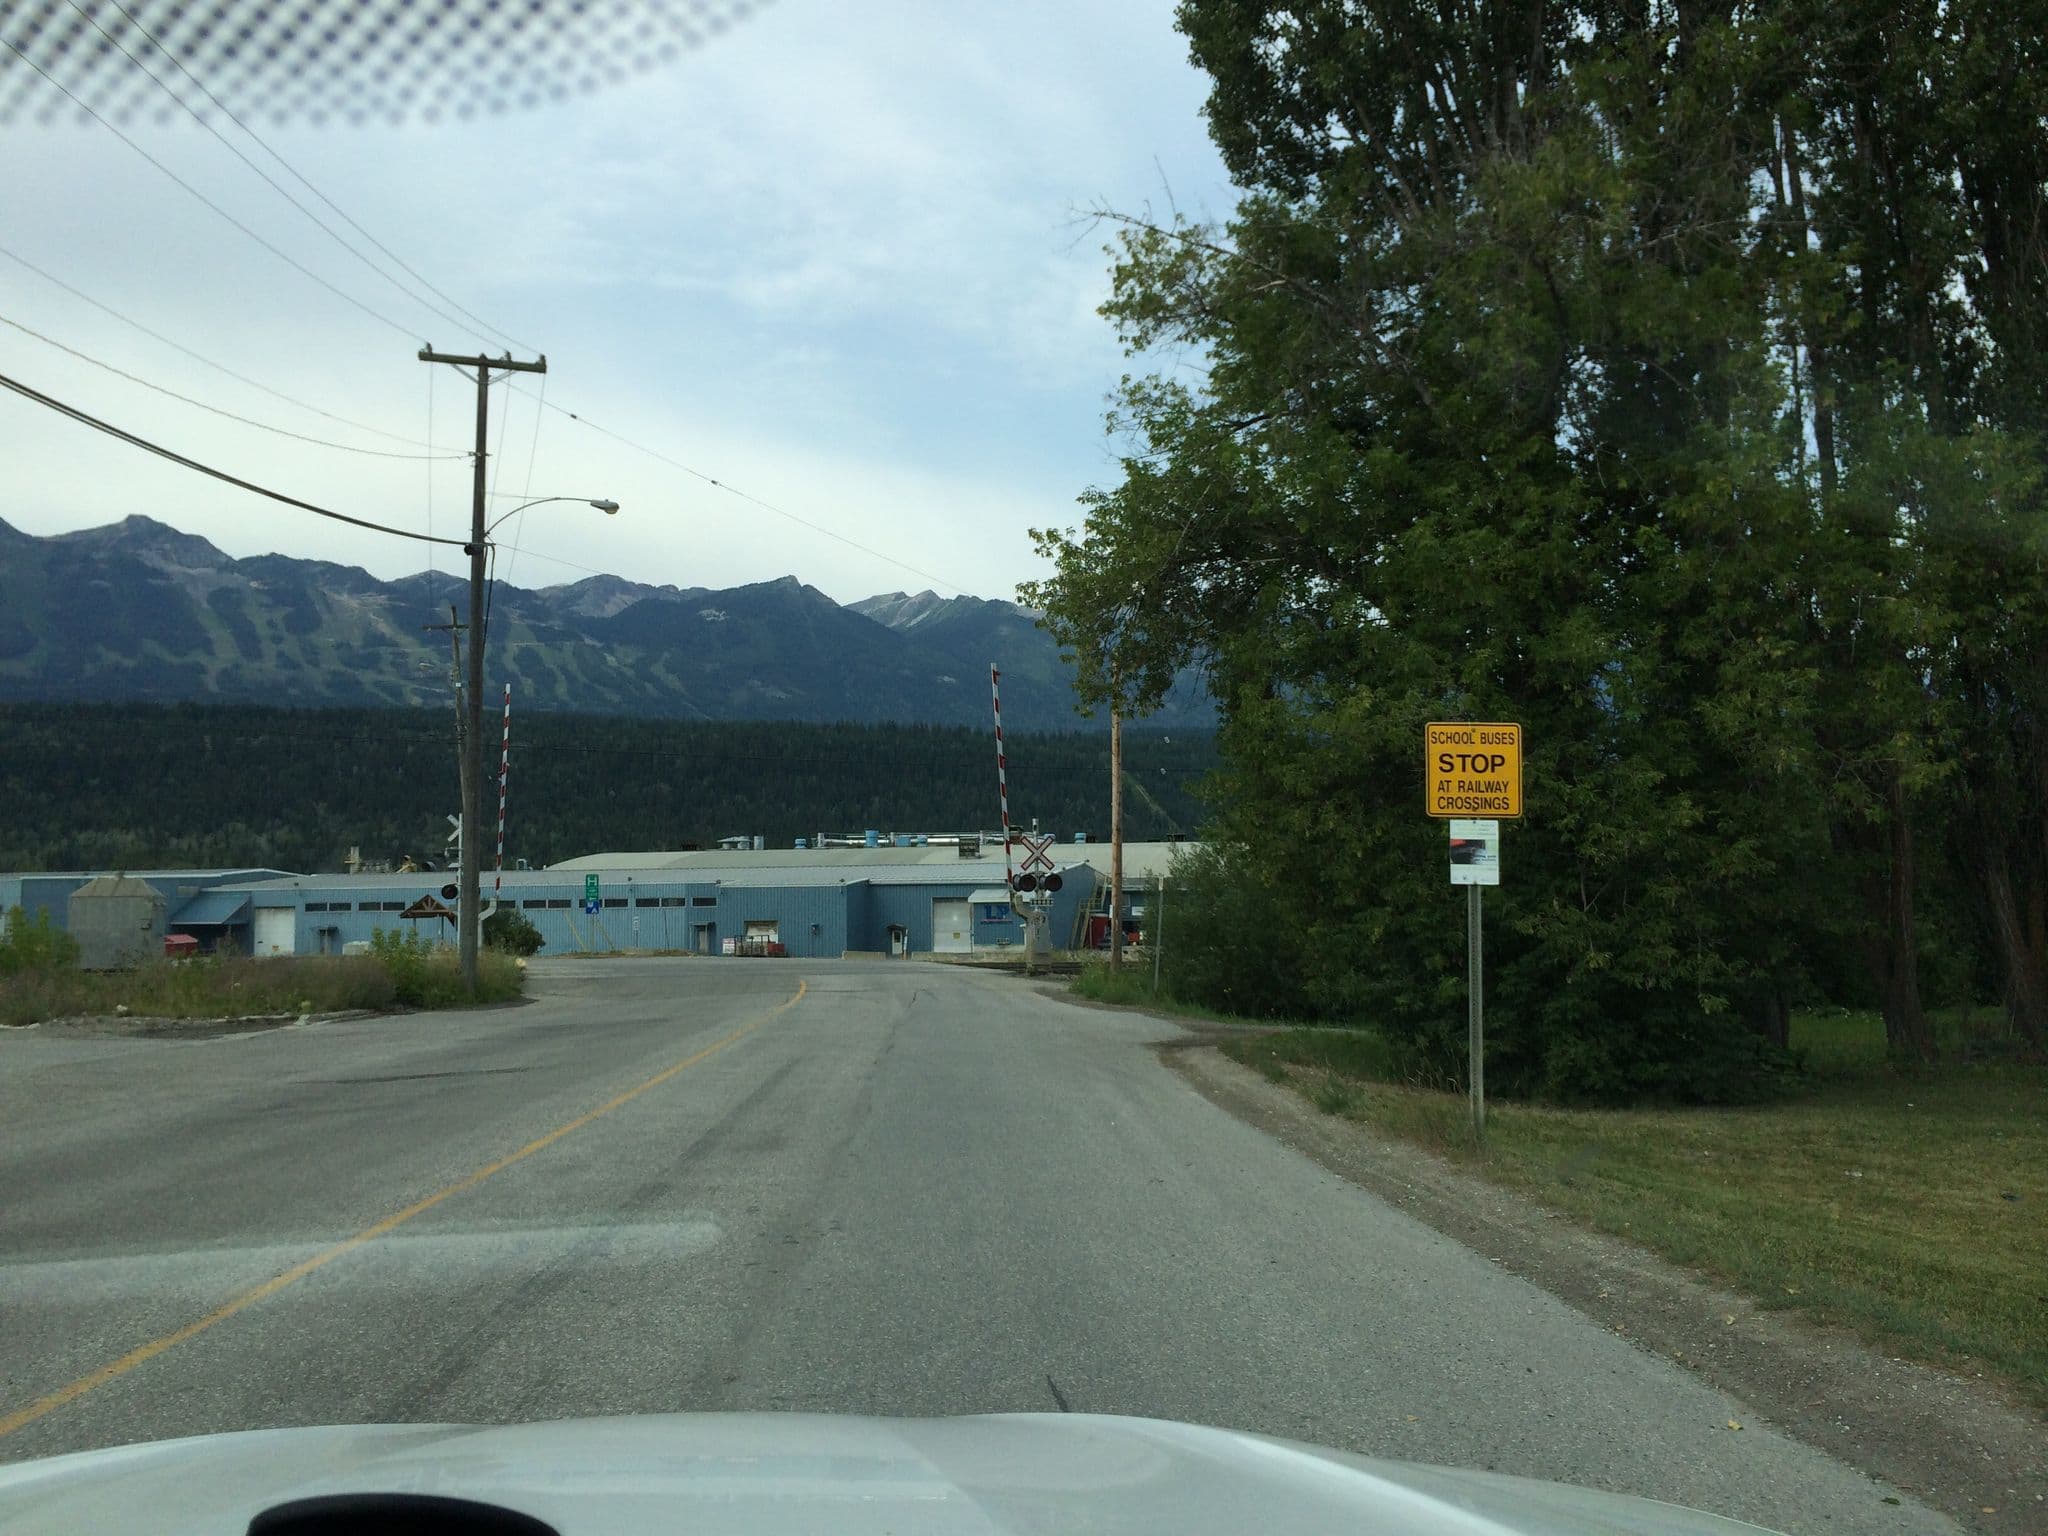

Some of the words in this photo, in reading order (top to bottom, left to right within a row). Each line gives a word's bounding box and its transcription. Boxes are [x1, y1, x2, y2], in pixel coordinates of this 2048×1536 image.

[1430, 731, 1476, 745] SCHOOL
[1480, 732, 1515, 745] BUSES
[1438, 753, 1506, 774] STOP
[1437, 780, 1452, 793] AT
[1457, 780, 1509, 793] RAILWAY
[1437, 796, 1510, 810] CROSSINGS
[587, 877, 598, 887] H
